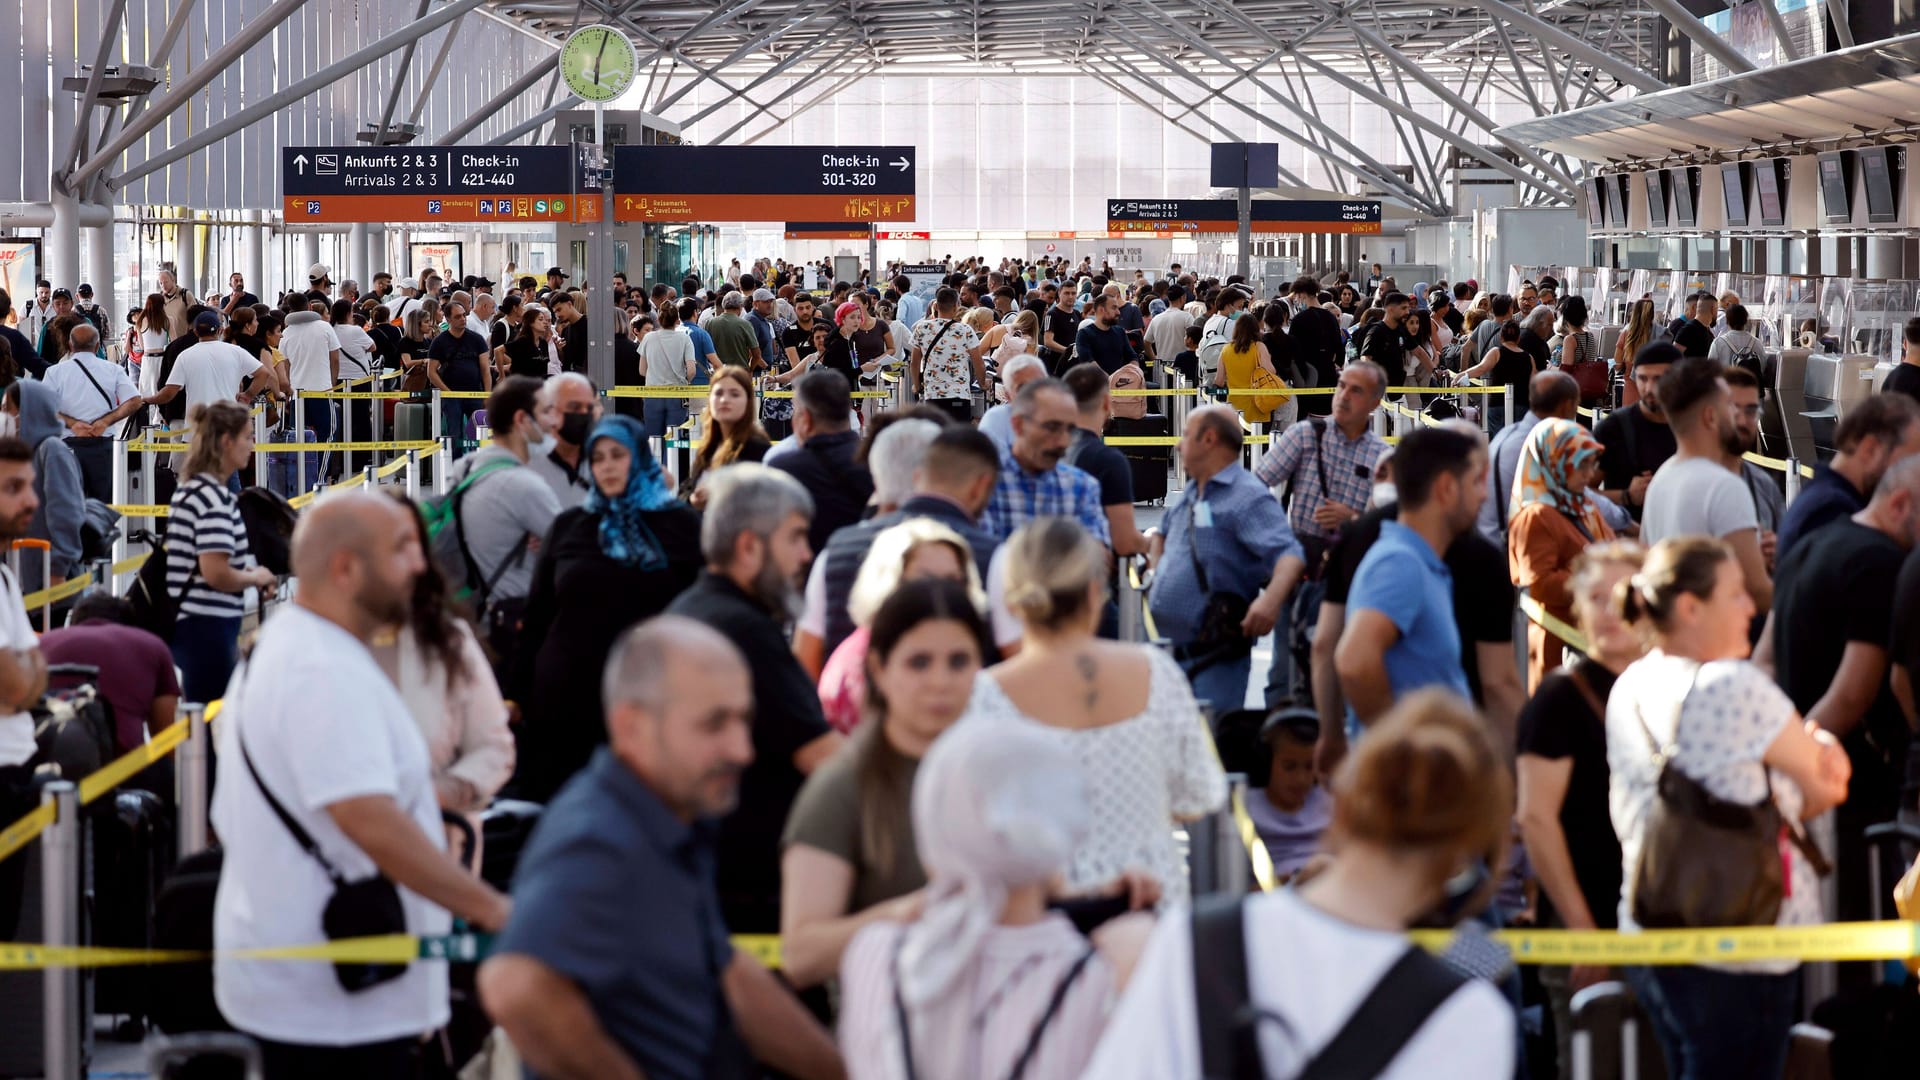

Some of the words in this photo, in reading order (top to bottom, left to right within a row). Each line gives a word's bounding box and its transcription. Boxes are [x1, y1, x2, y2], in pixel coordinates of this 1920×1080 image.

[345, 155, 397, 168] Ankunft
[402, 155, 410, 168] 2
[415, 155, 424, 168] &
[429, 155, 437, 168] 3
[462, 154, 519, 168] Check-in
[822, 154, 880, 167] Check-in
[345, 174, 396, 187] Arrivals
[402, 174, 410, 186] 2
[415, 174, 424, 186] &
[429, 174, 437, 186] 3
[462, 174, 514, 186] 421-440
[822, 174, 876, 186] 301-320
[307, 201, 320, 214] P2
[428, 201, 440, 213] P2
[480, 201, 493, 213] PN
[498, 201, 511, 213] P3
[536, 200, 546, 212] S
